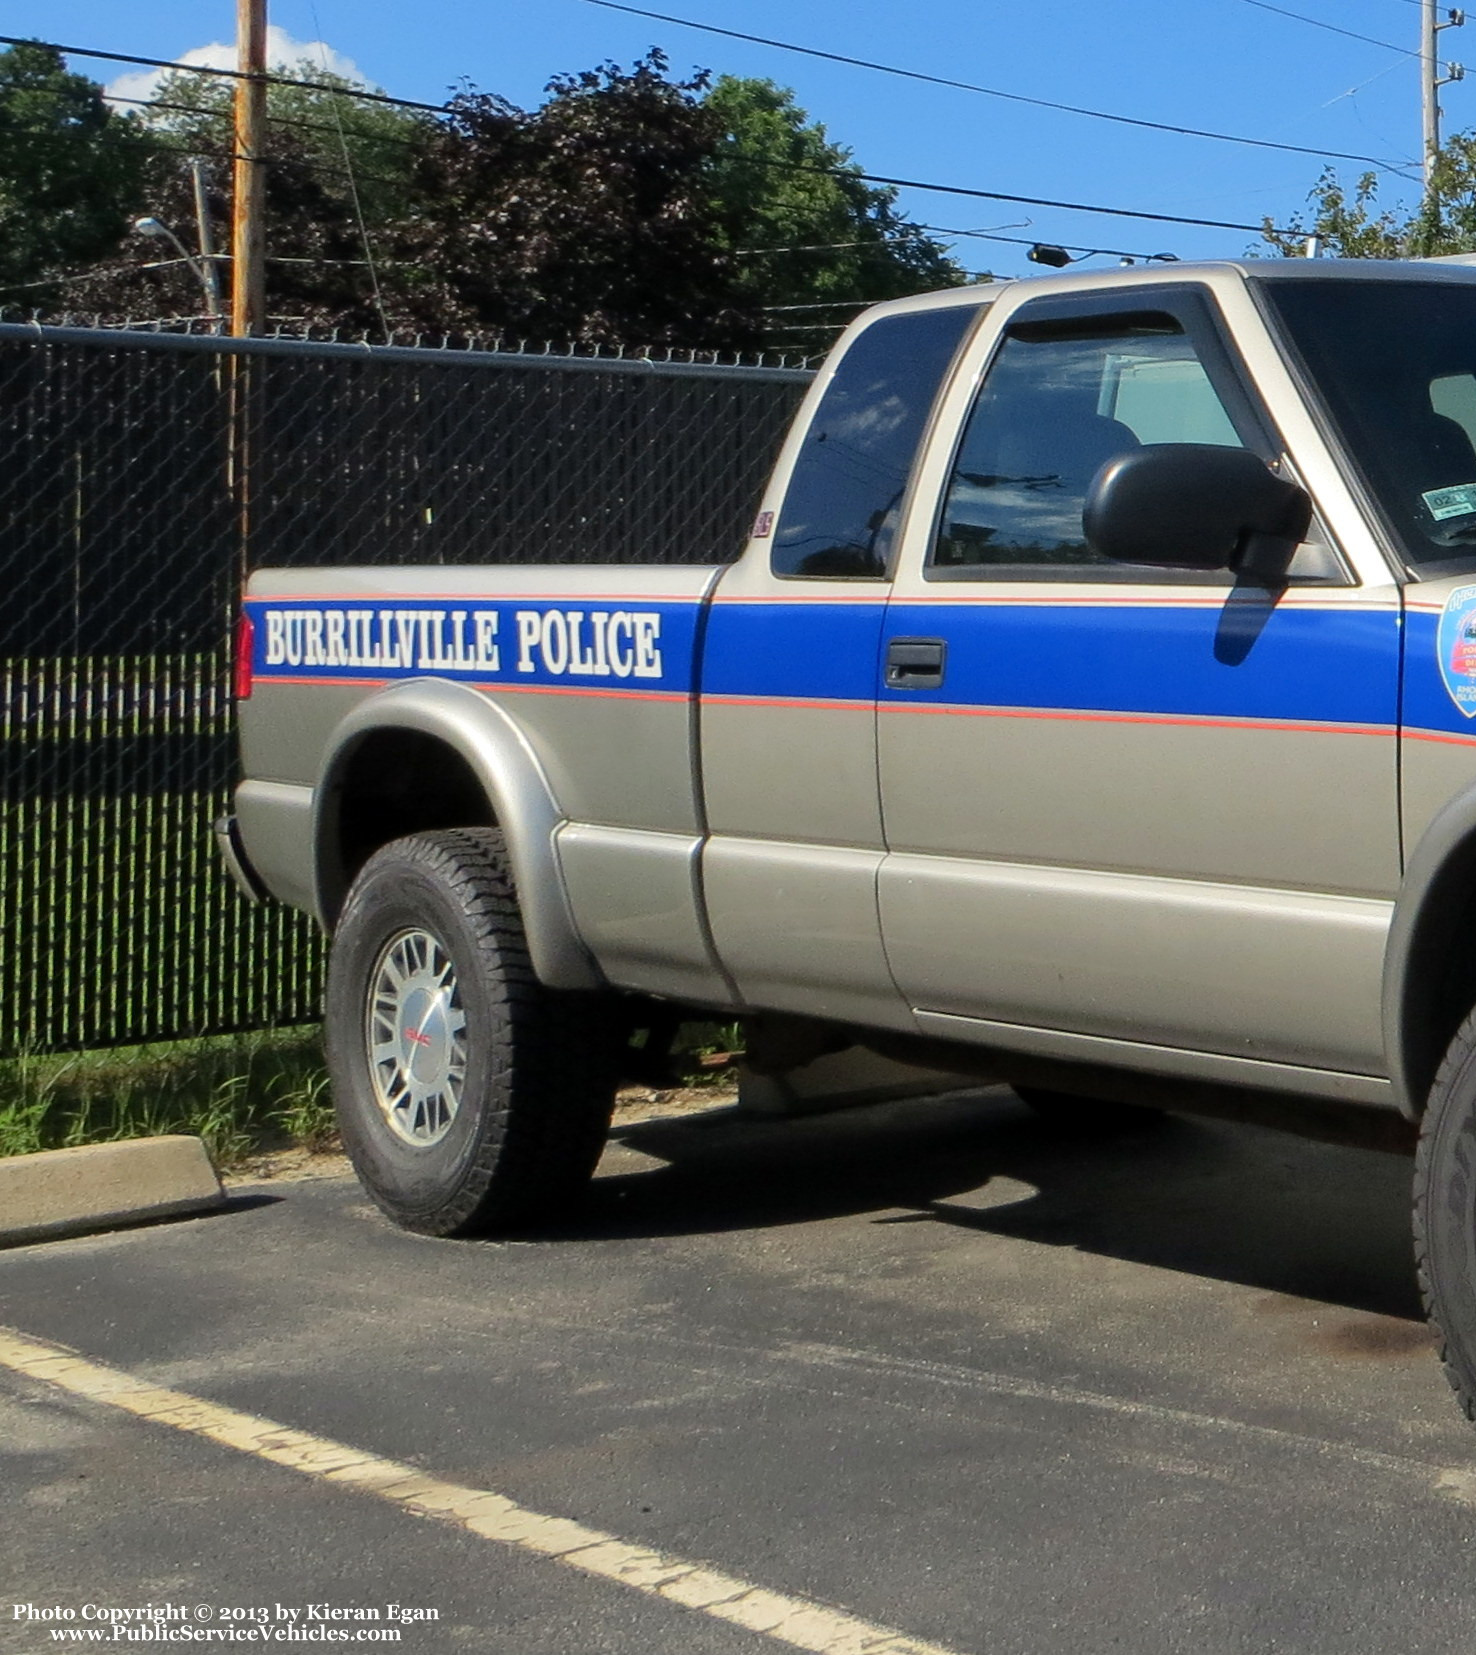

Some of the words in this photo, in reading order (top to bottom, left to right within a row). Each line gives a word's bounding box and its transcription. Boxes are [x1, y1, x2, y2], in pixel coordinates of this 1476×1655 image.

[265, 610, 500, 671] BURRILLVILLE
[516, 610, 662, 678] POLICE
[403, 1026, 432, 1048] GMC
